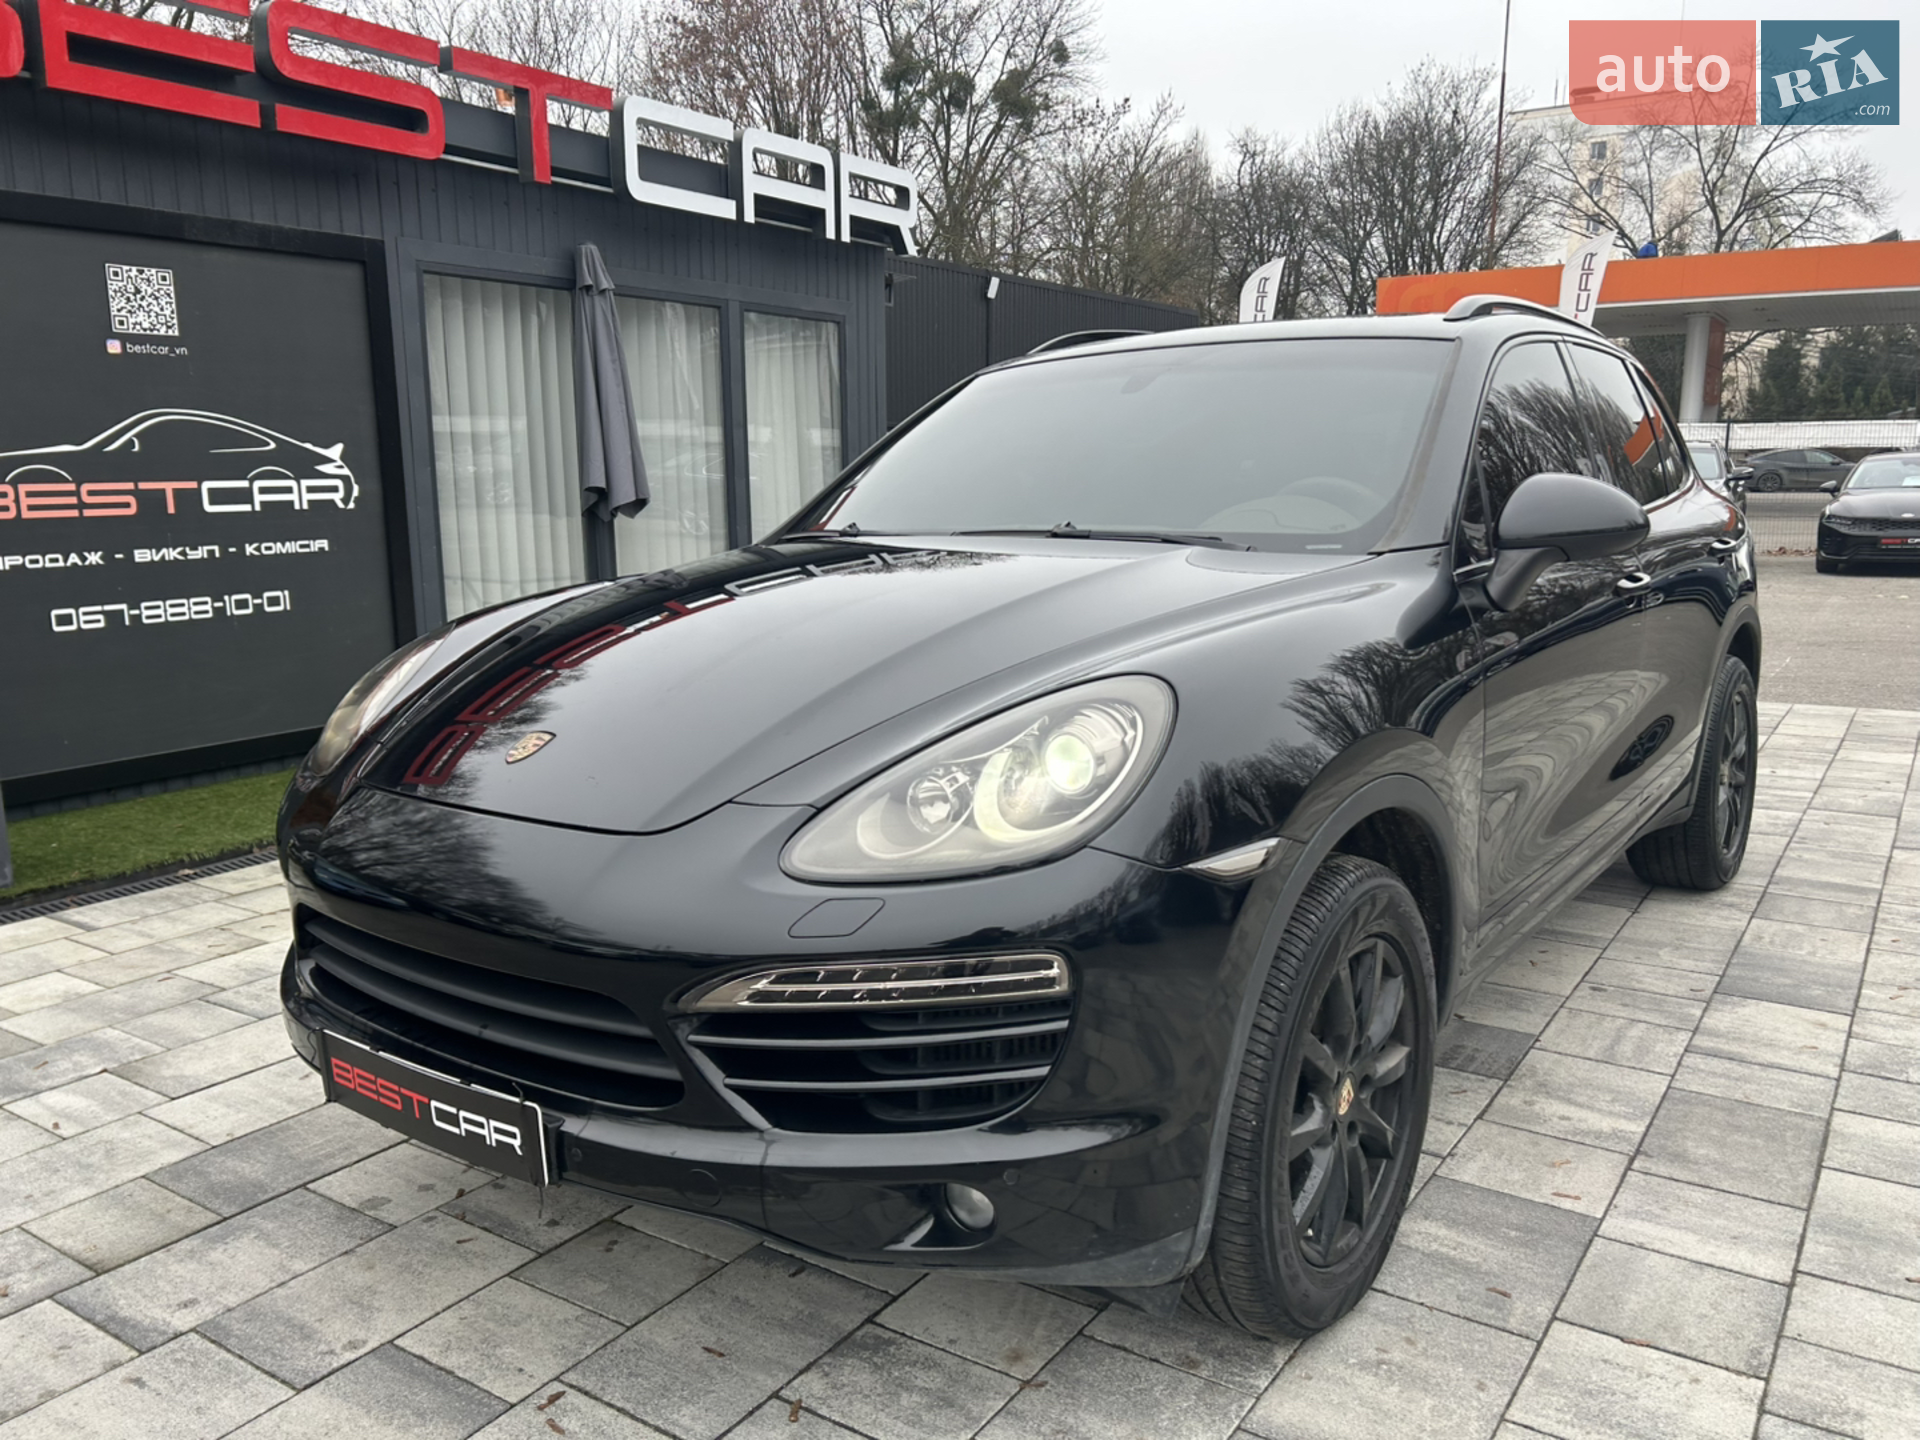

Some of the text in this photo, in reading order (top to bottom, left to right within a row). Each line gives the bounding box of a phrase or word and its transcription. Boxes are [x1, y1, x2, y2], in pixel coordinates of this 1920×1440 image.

[0, 0, 918, 255] ESTCAR
[125, 342, 188, 357] bestcar_vn
[0, 478, 346, 520] ESTCAR
[133, 545, 220, 563] ВИКУП
[245, 539, 329, 556] КОМІСІЯ
[50, 590, 291, 632] 067-888-10-01
[331, 1057, 523, 1156] BESTCAR
